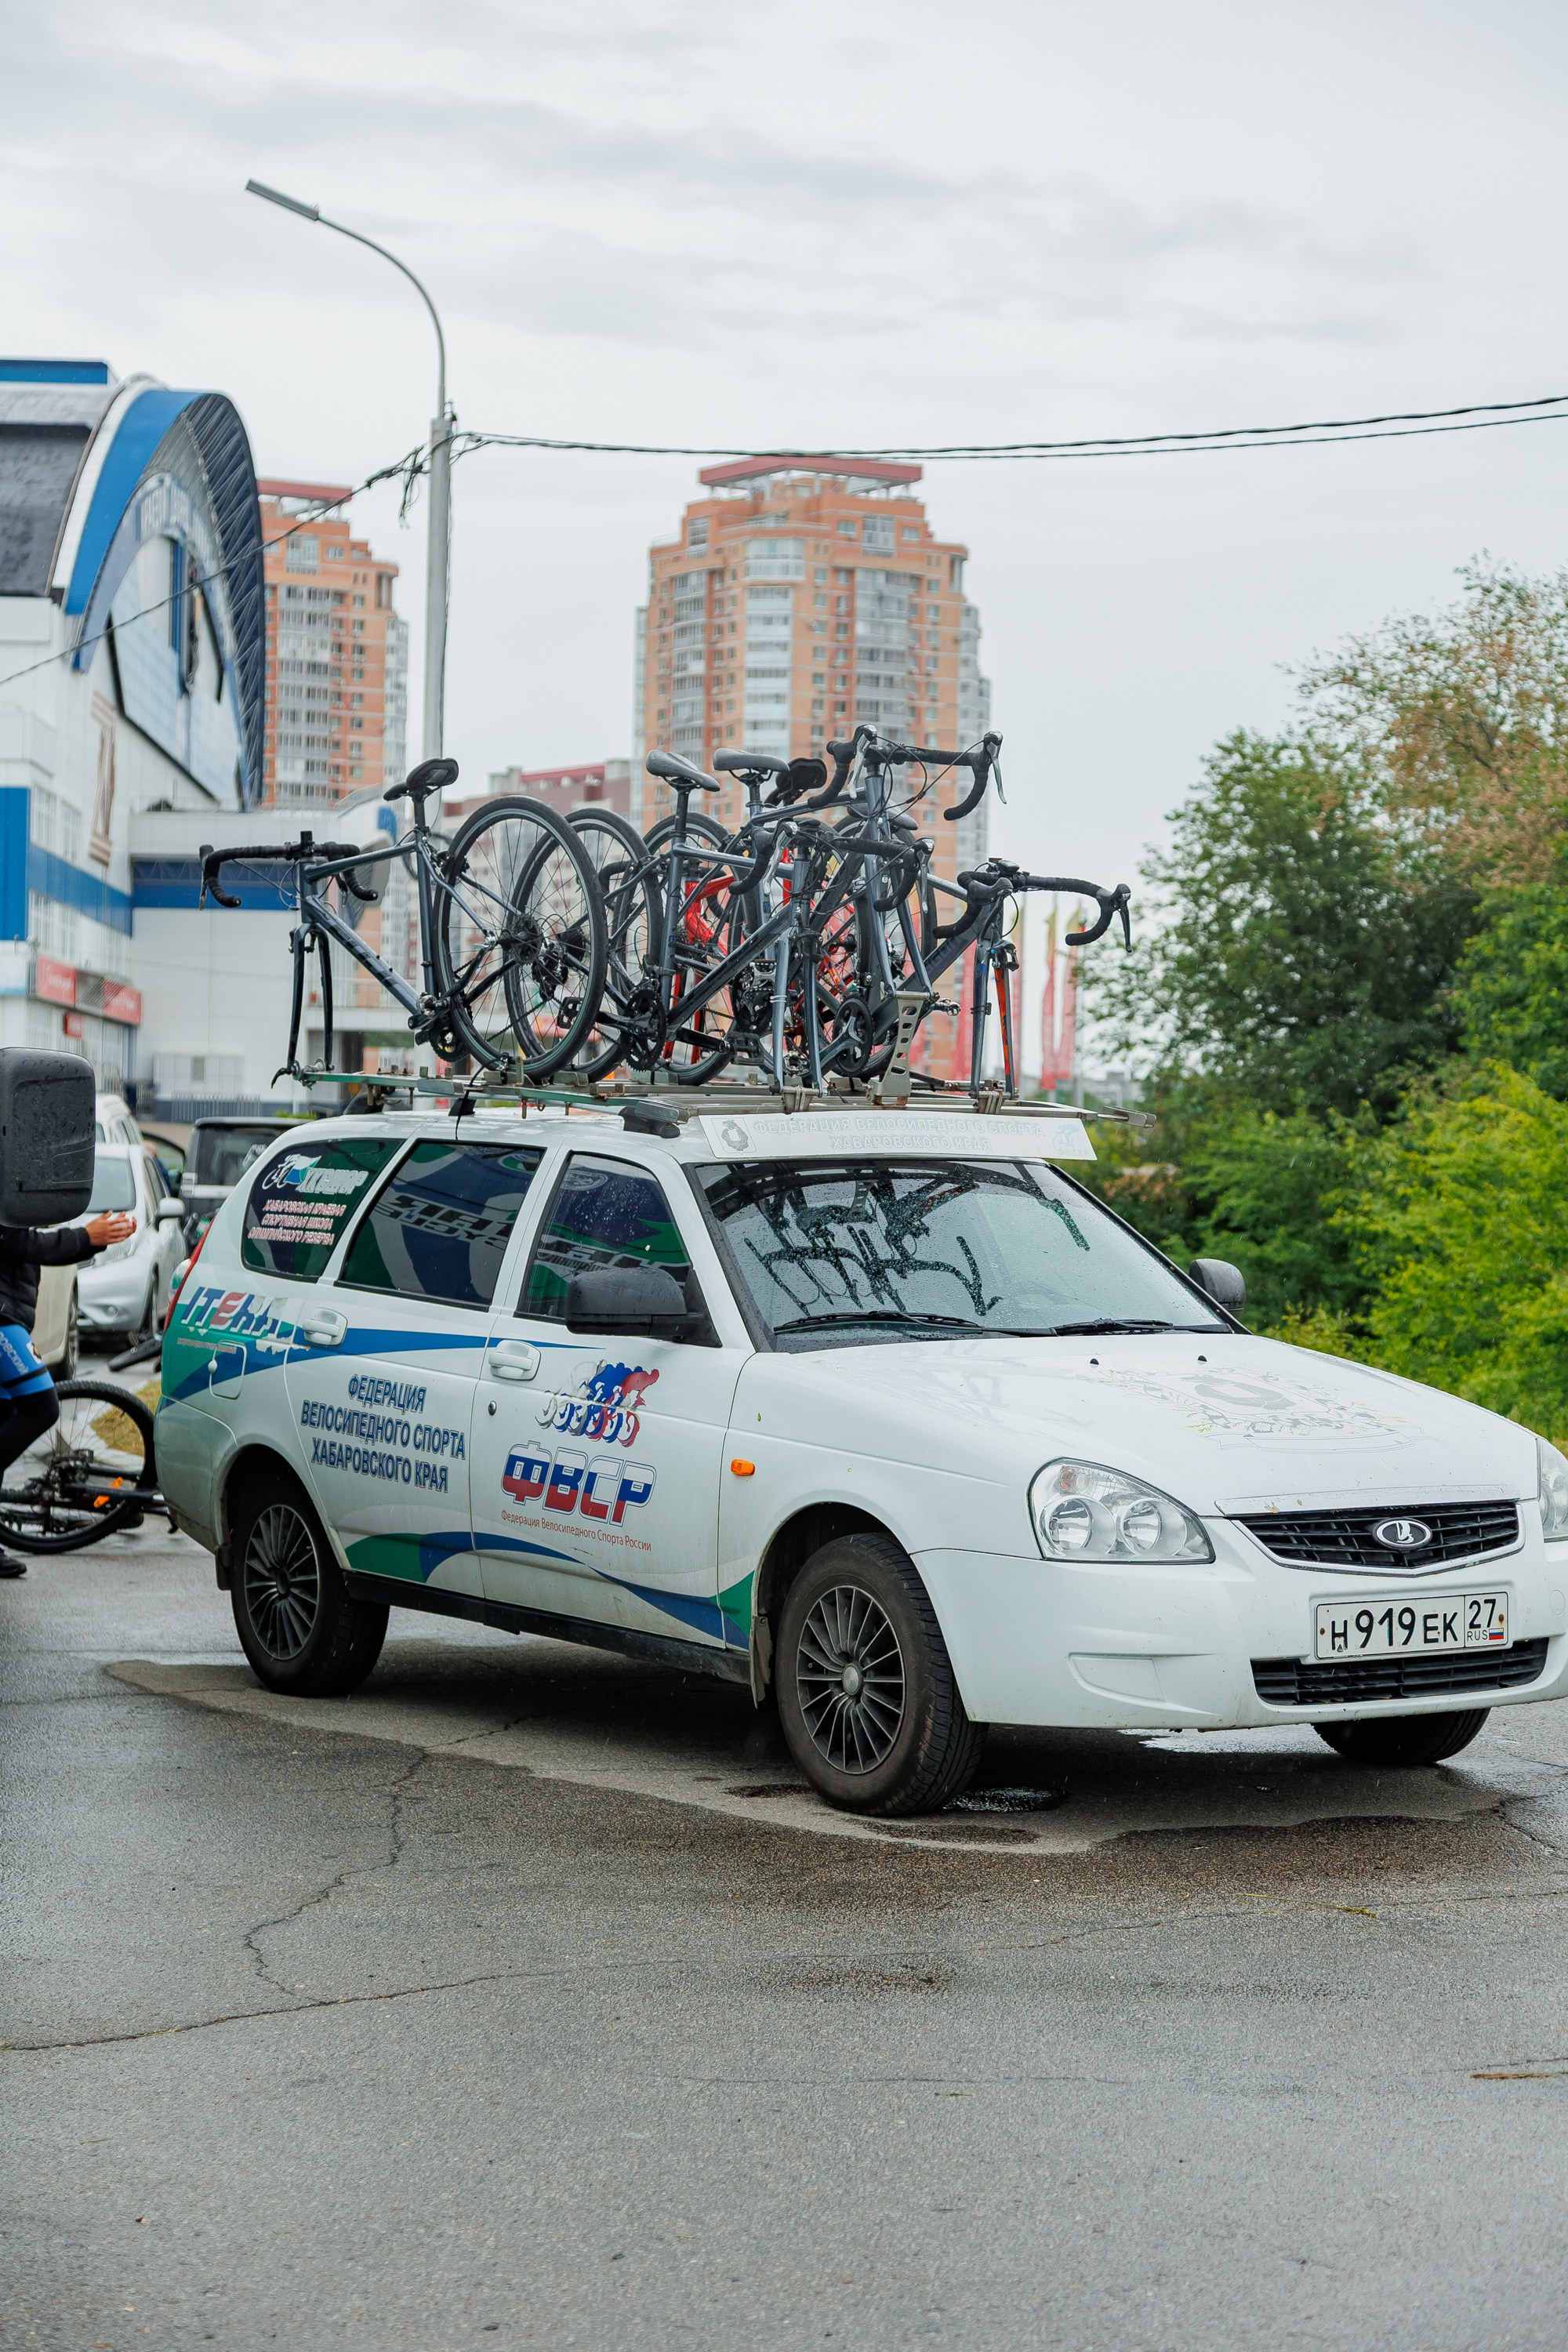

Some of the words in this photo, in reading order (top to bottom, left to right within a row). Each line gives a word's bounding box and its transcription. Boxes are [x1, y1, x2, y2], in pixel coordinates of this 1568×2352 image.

[753, 1117, 852, 1136] ФЕДЕРАЦИЯ
[856, 1116, 985, 1134] ВЕЛОСИПЕДНОГО
[988, 1121, 1046, 1137] СПОРТА
[831, 1135, 951, 1150] ХАБАРОВСКОГО
[954, 1137, 992, 1152] КРАЯ
[263, 1200, 314, 1214] ХАБАРОВСКАЯ
[312, 1202, 347, 1217] КРАЕВАЯ
[261, 1213, 307, 1228] СПОРТИВНАЯ
[305, 1216, 334, 1230] ШКОЛА
[248, 1226, 303, 1243] ОЛИМПИЙСКОГО
[301, 1232, 335, 1246] РЕЗЕРВА
[348, 1374, 427, 1415] ФЕДЕРАЦИЯ
[300, 1399, 411, 1447] ВЕЛОСИПЕДНОГО
[412, 1423, 466, 1461] СПОРТА
[311, 1436, 412, 1485] ХАБАРОВСКОГО
[414, 1459, 448, 1494] КРАЯ
[500, 1439, 657, 1528] ФВСР
[501, 1509, 540, 1527] Федерация
[541, 1517, 596, 1541] Велосипедного
[597, 1530, 624, 1547] Спорта
[625, 1536, 652, 1552] России
[1468, 1599, 1497, 1629] 27
[1467, 1630, 1488, 1642] RUS
